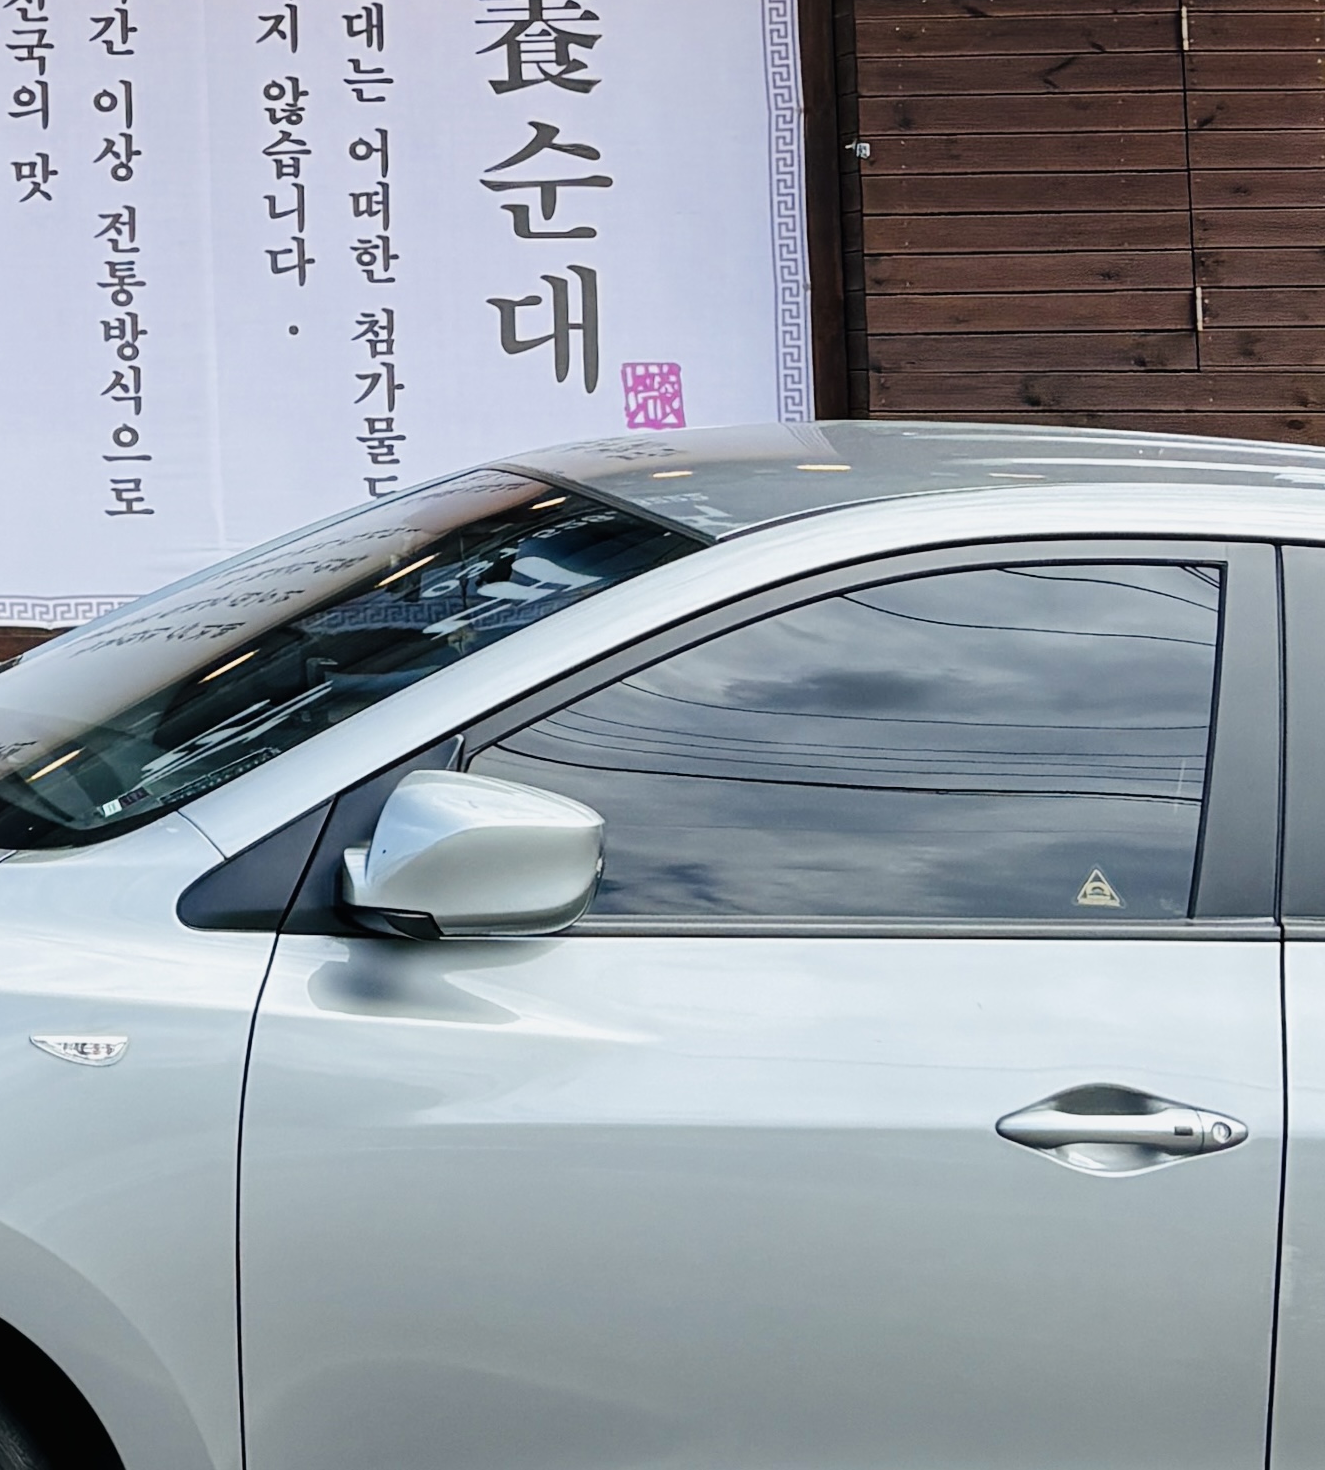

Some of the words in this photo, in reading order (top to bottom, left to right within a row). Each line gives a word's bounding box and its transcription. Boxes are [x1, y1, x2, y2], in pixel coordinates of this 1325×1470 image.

[11, 153, 58, 202] 맛
[93, 80, 142, 181] 이상
[349, 128, 399, 283] 어떠한
[94, 205, 154, 516] 전통방식으로
